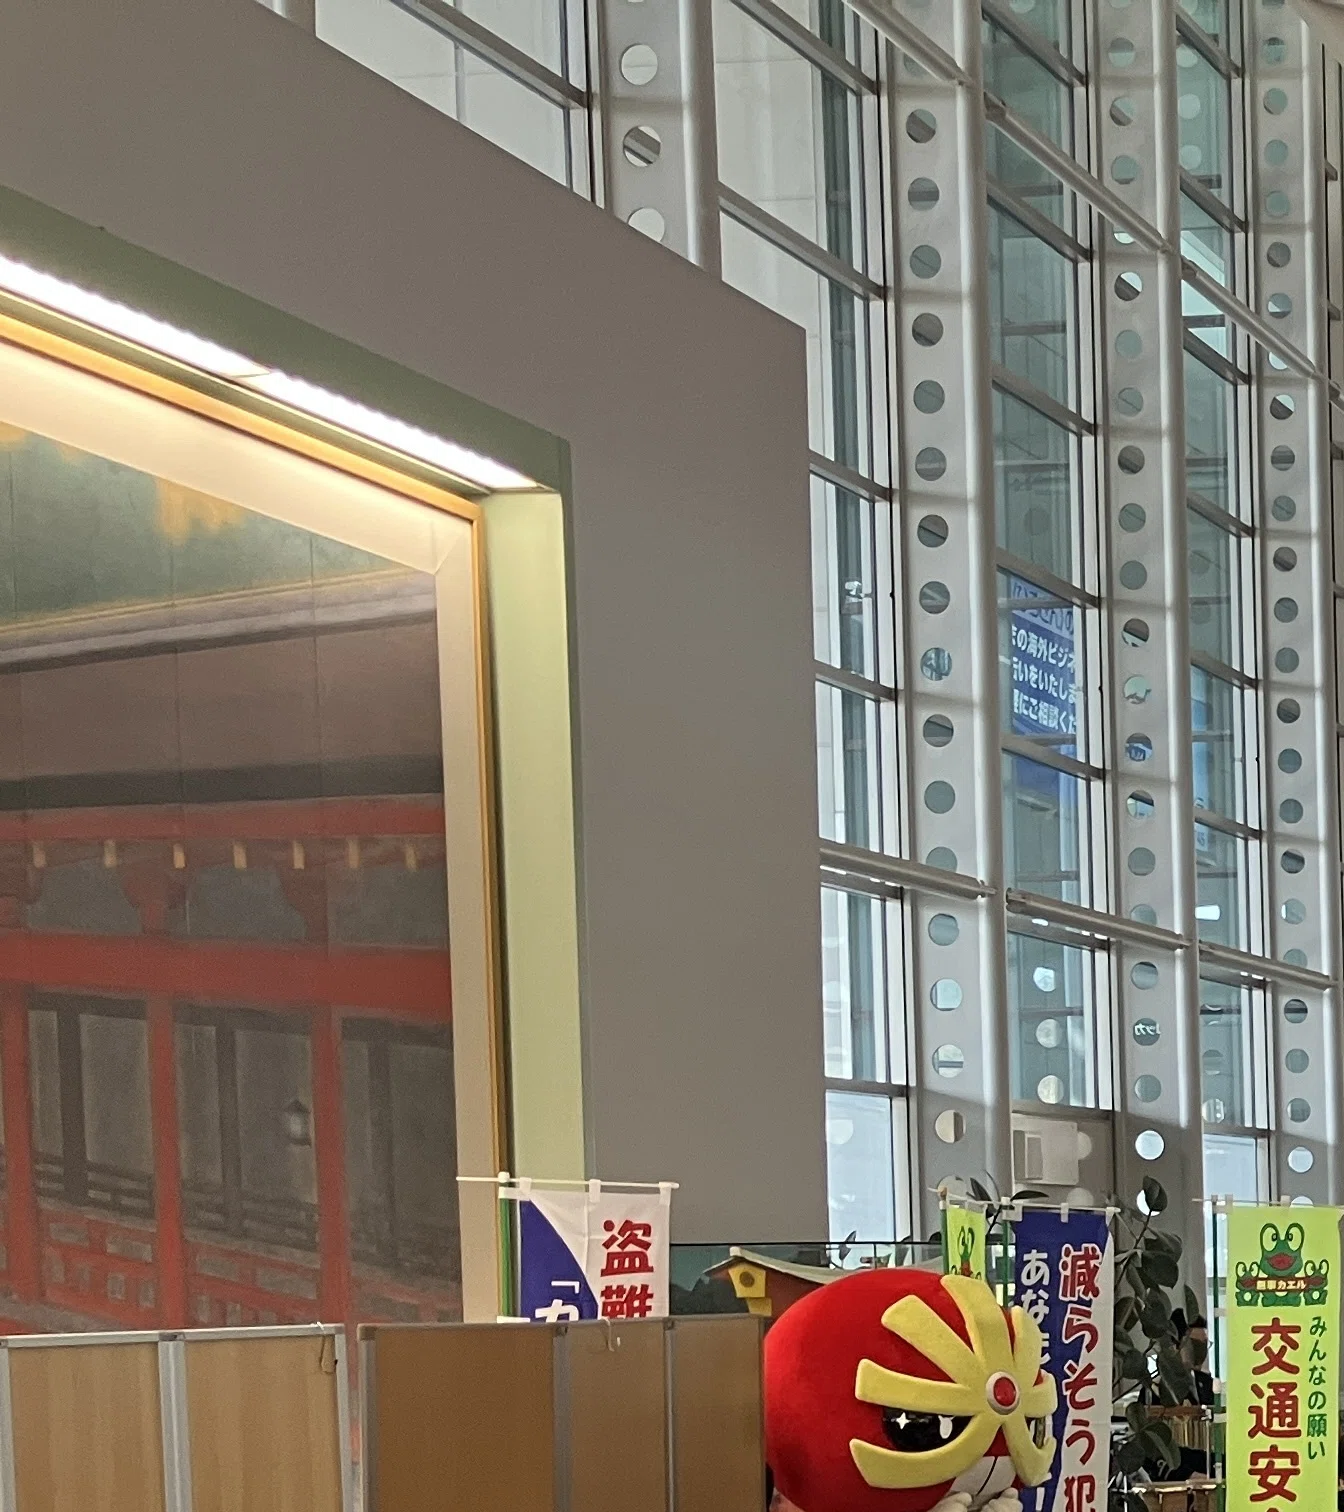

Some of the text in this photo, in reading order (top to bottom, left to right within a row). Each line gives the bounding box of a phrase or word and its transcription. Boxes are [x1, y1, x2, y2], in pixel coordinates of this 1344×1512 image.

[600, 1219, 655, 1318] 盗難
[1307, 1315, 1328, 1461] みんなの願い
